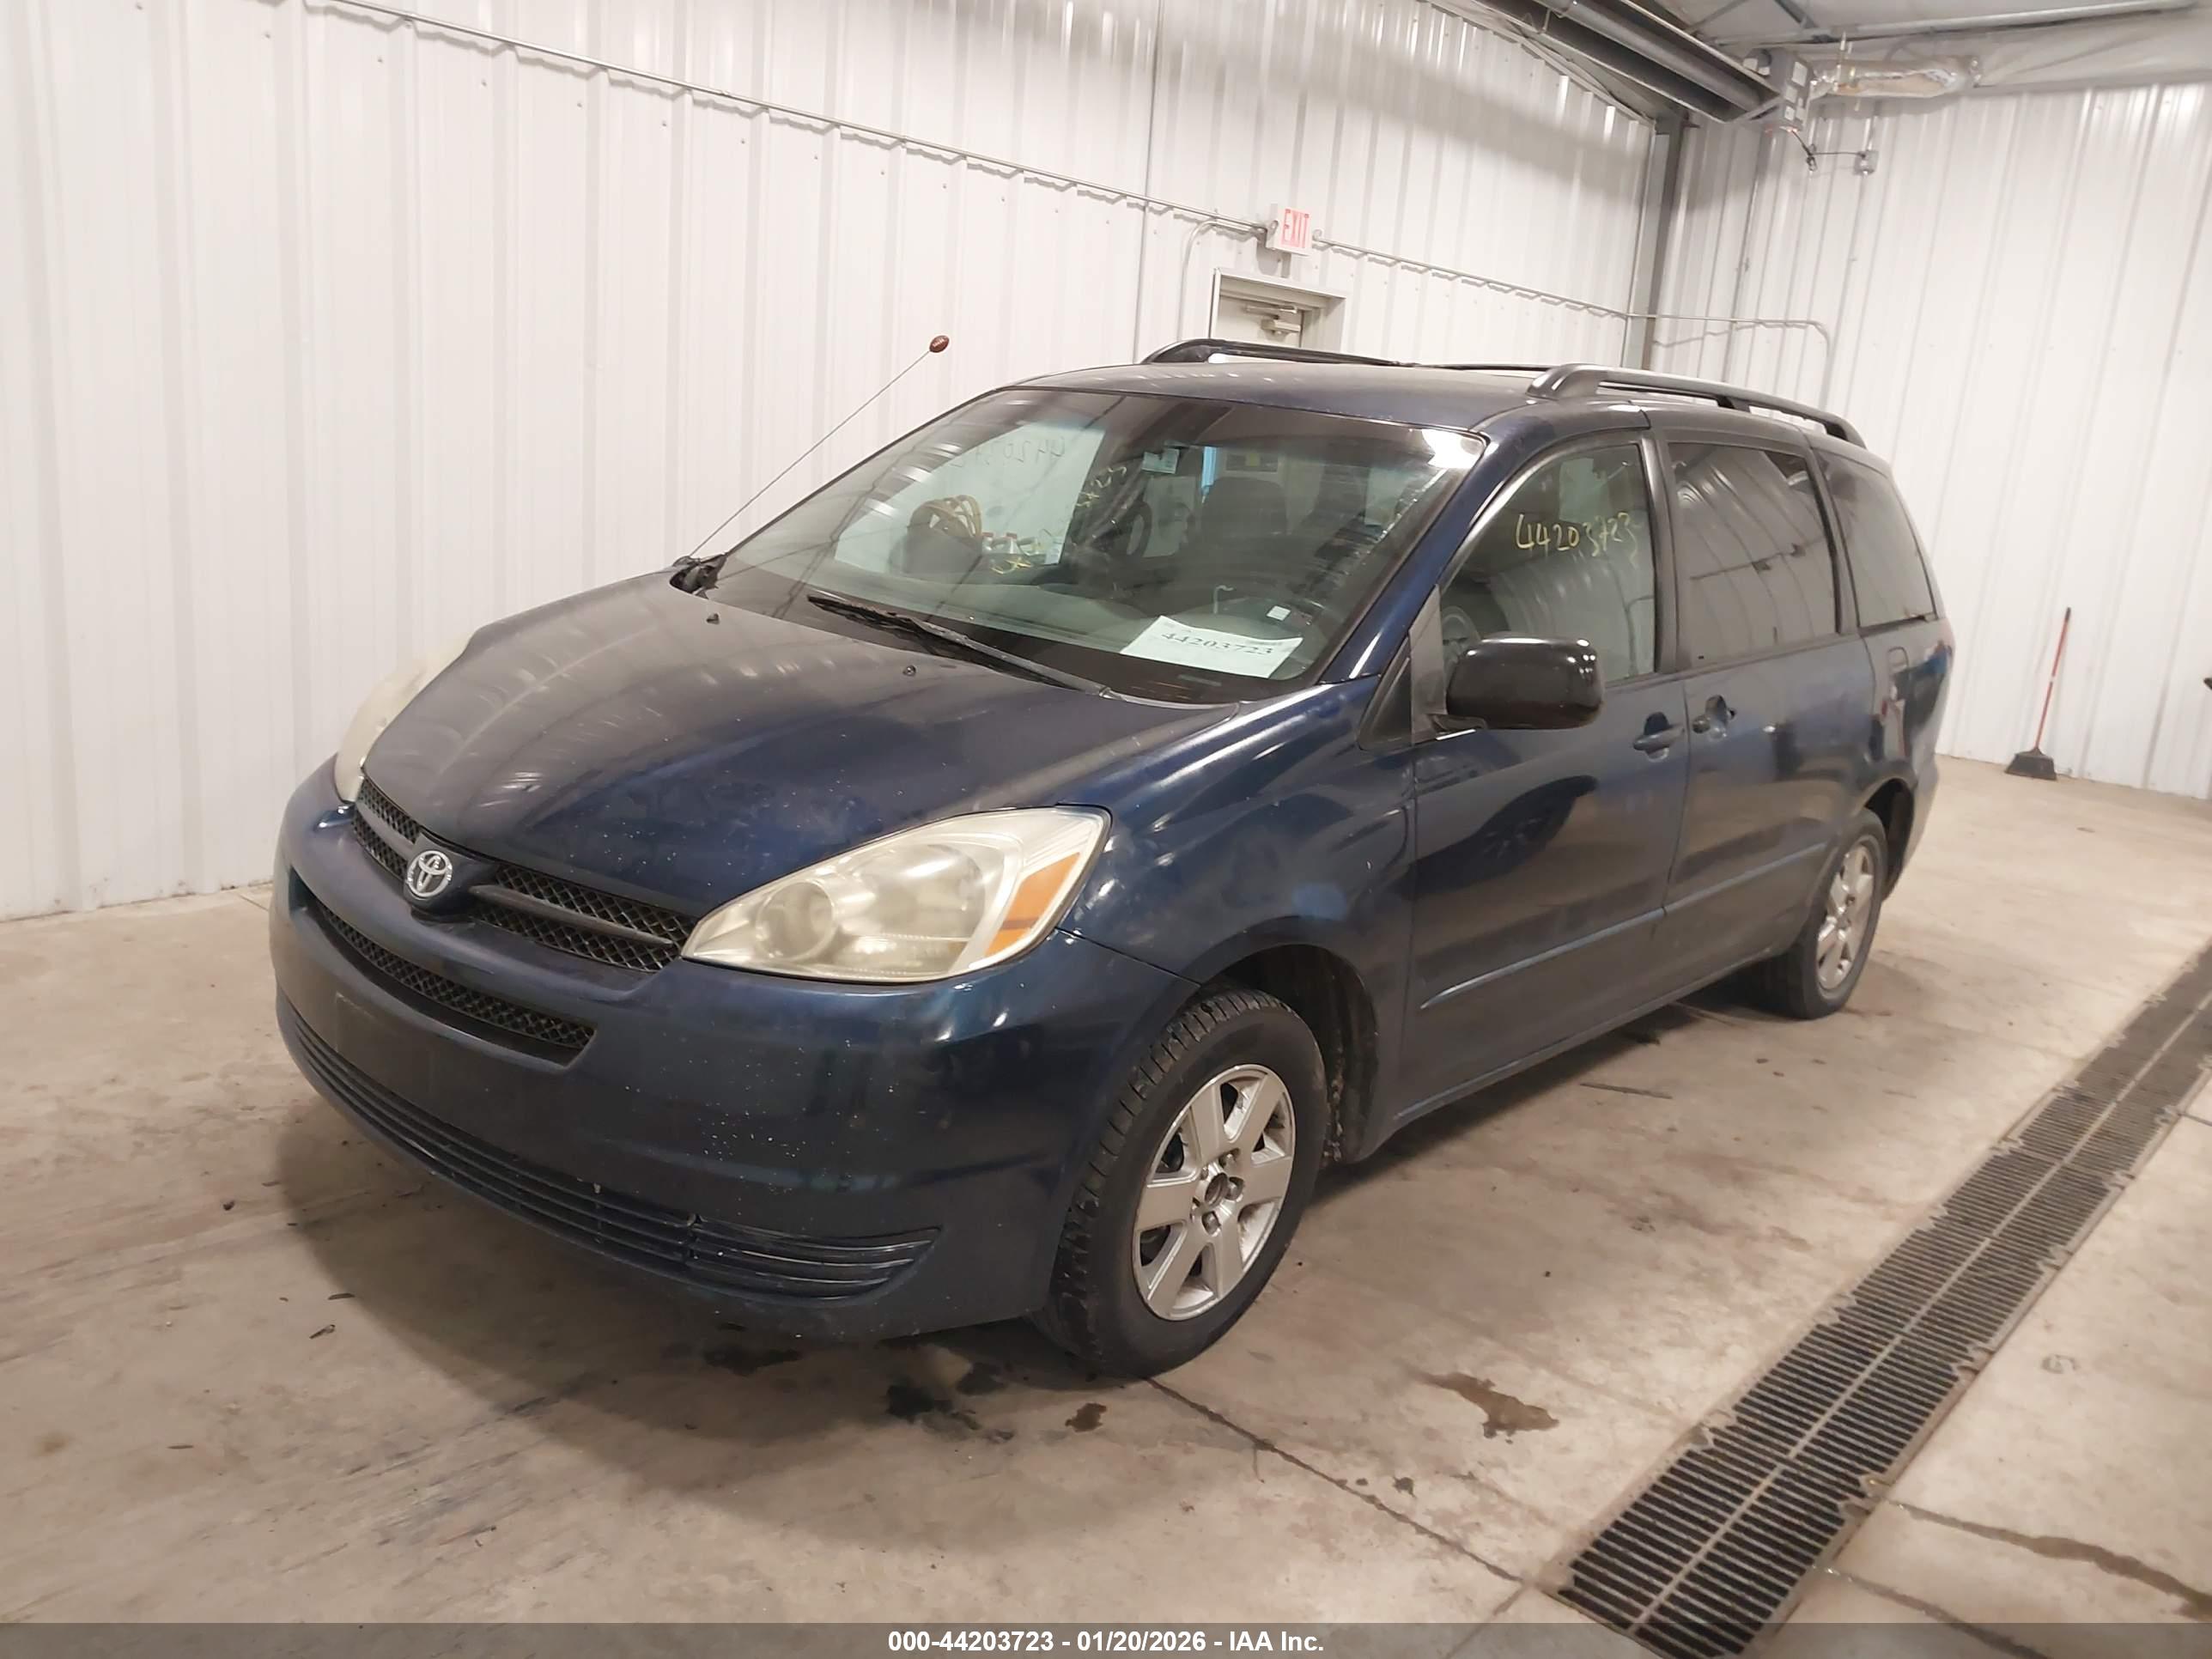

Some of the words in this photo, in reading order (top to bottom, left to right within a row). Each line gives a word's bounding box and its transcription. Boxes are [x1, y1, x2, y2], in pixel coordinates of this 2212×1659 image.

[1281, 209, 1310, 249] EXIT
[1516, 512, 1638, 562] 44203723
[1161, 633, 1273, 656] 44203723
